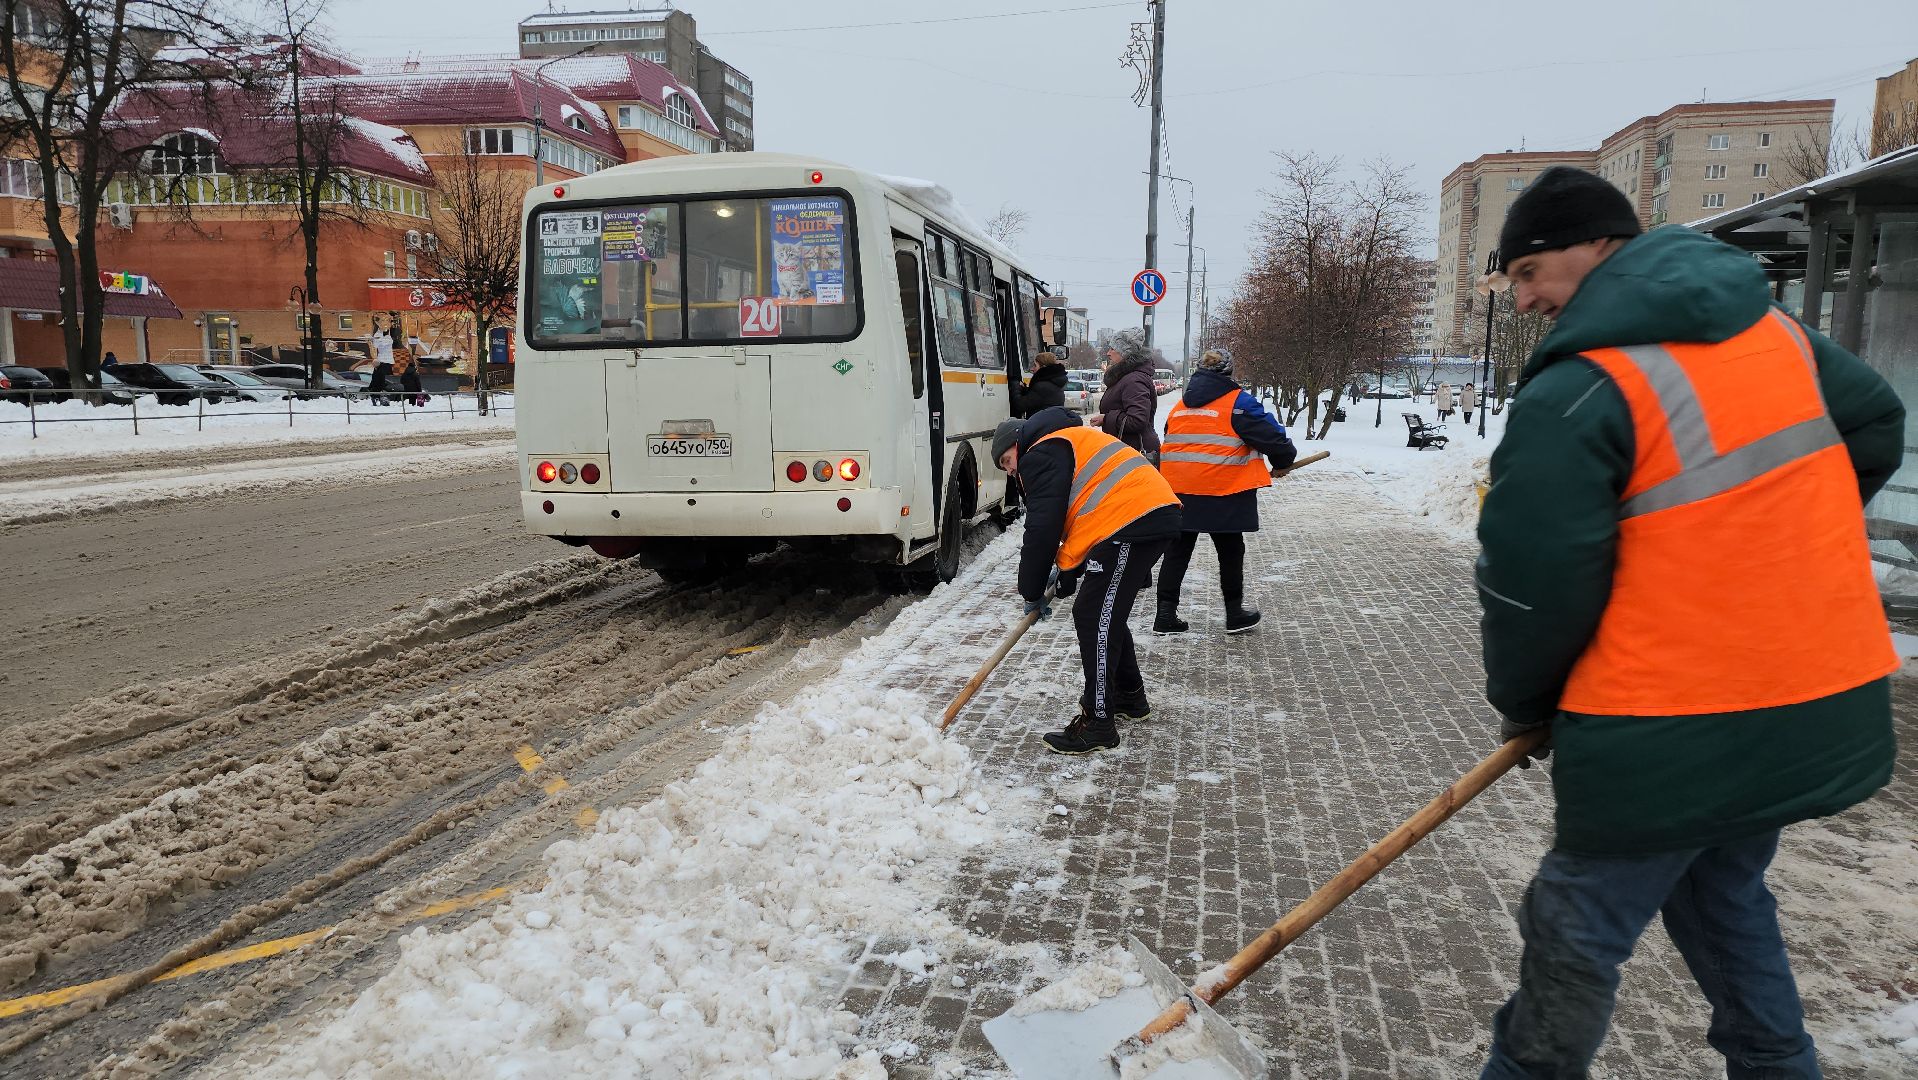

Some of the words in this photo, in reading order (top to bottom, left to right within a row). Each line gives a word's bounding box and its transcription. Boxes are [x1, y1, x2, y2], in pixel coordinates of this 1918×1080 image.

[775, 216, 836, 237] КОШЕК
[543, 257, 595, 275] БАБОЧЕК
[99, 271, 143, 294] baby
[742, 298, 778, 332] 20
[835, 362, 851, 371] СНГ
[652, 440, 705, 455] О645УО
[706, 439, 727, 450] 750
